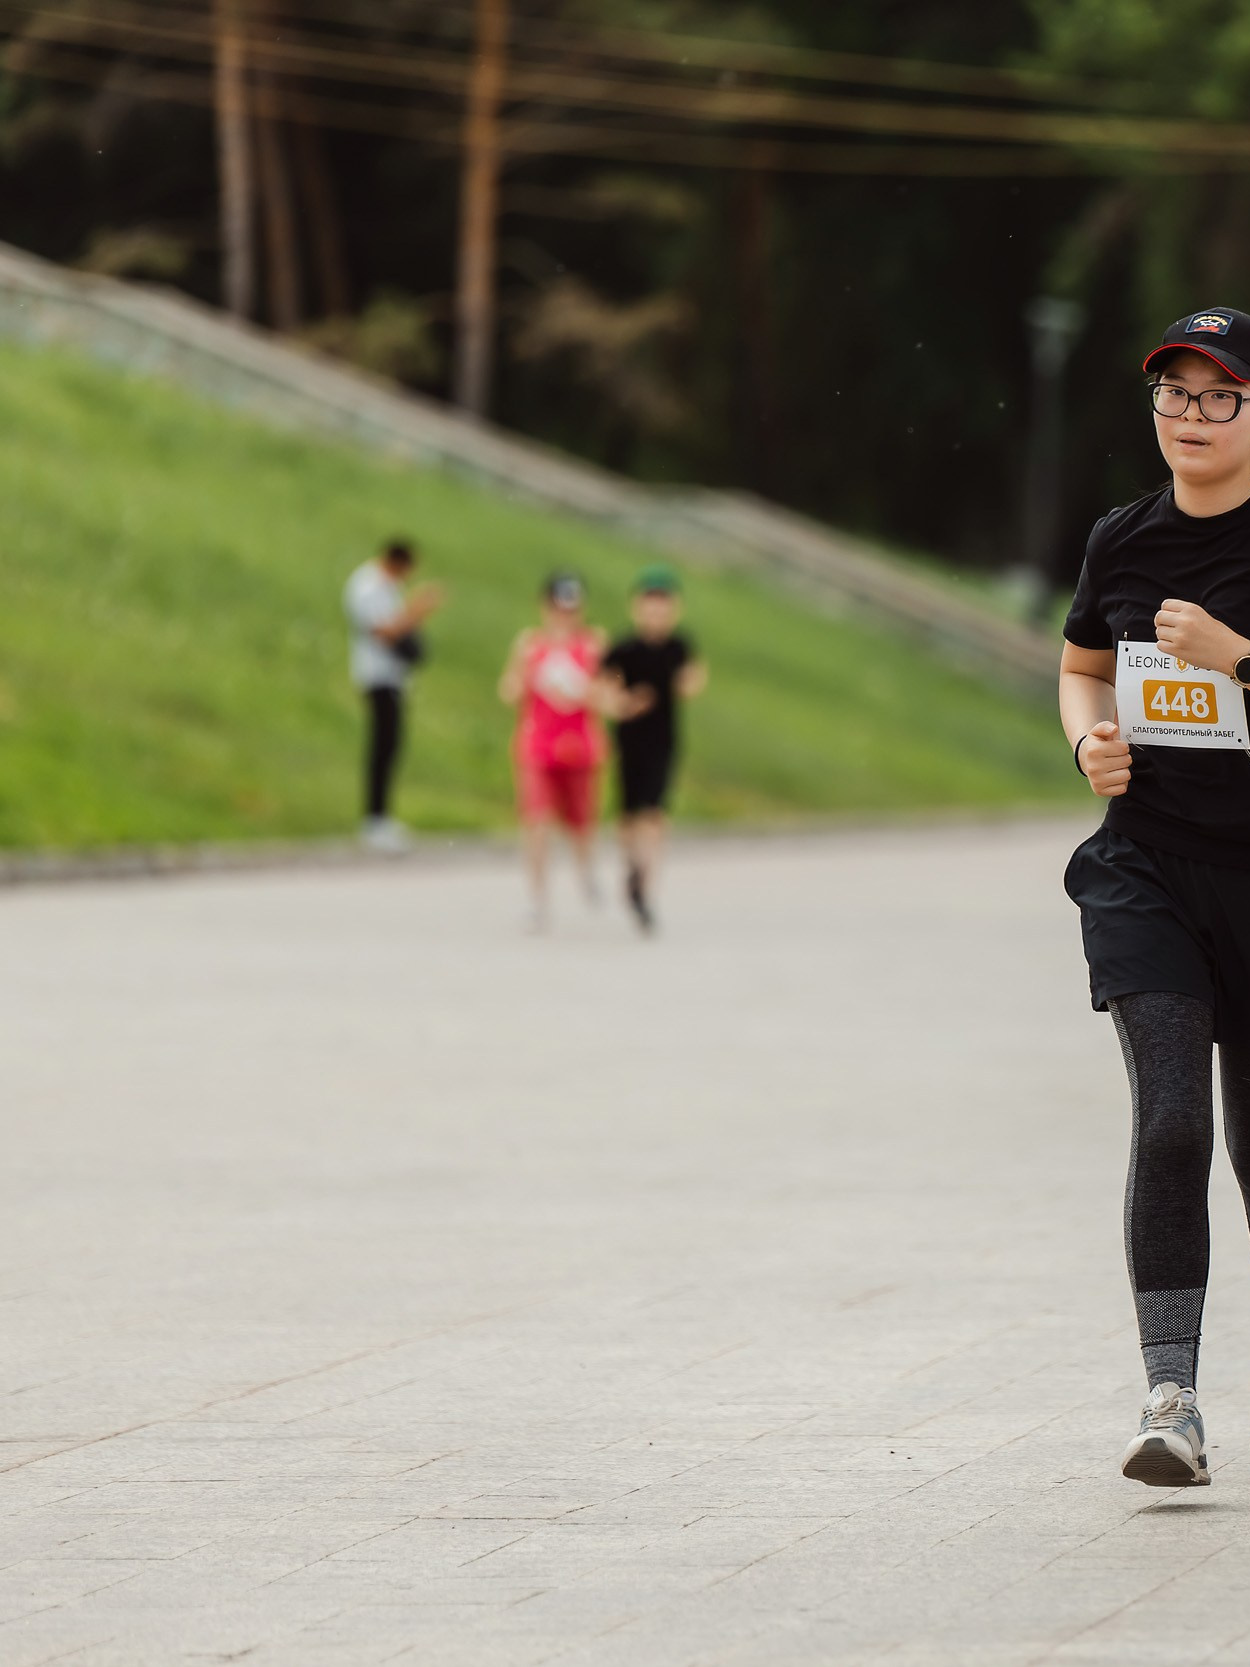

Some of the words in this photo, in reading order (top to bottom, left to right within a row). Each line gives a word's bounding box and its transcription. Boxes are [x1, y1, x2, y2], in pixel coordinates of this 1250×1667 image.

[1128, 655, 1171, 669] LEONE
[1150, 685, 1210, 719] 448
[1132, 725, 1213, 738] БЛАГОТВОРИТЕЛЬНЫЙ
[1214, 730, 1236, 738] ЗАБЕГ
